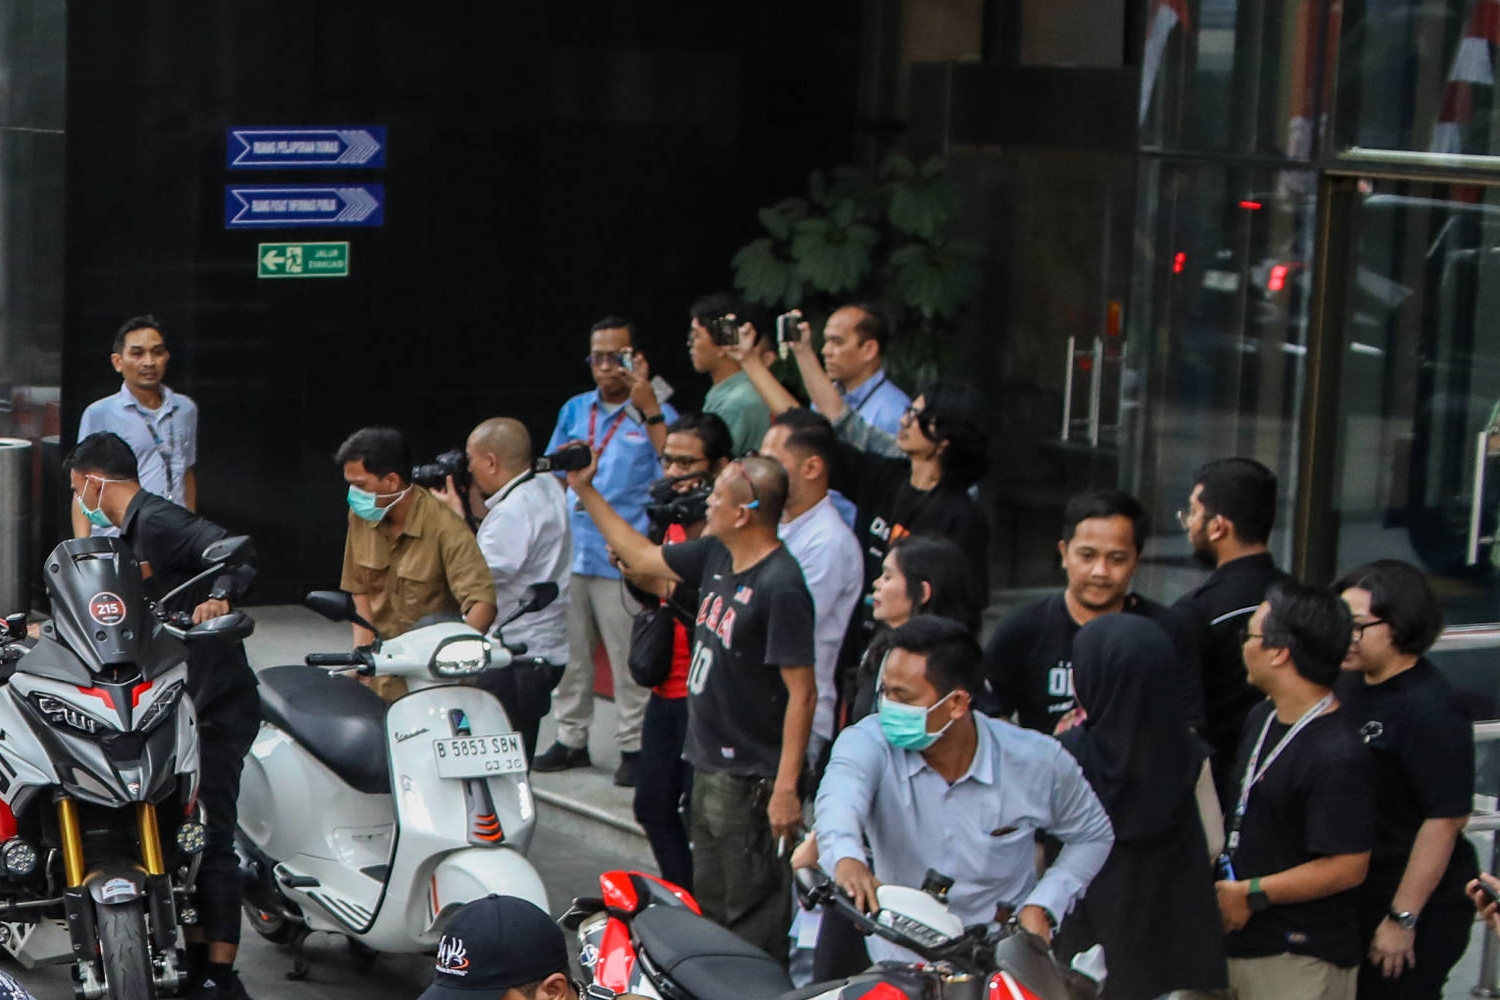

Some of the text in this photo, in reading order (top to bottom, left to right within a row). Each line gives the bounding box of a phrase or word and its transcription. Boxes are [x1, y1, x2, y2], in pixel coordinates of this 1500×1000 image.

[97, 603, 119, 615] 215
[437, 742, 446, 758] B
[452, 739, 487, 757] 5853
